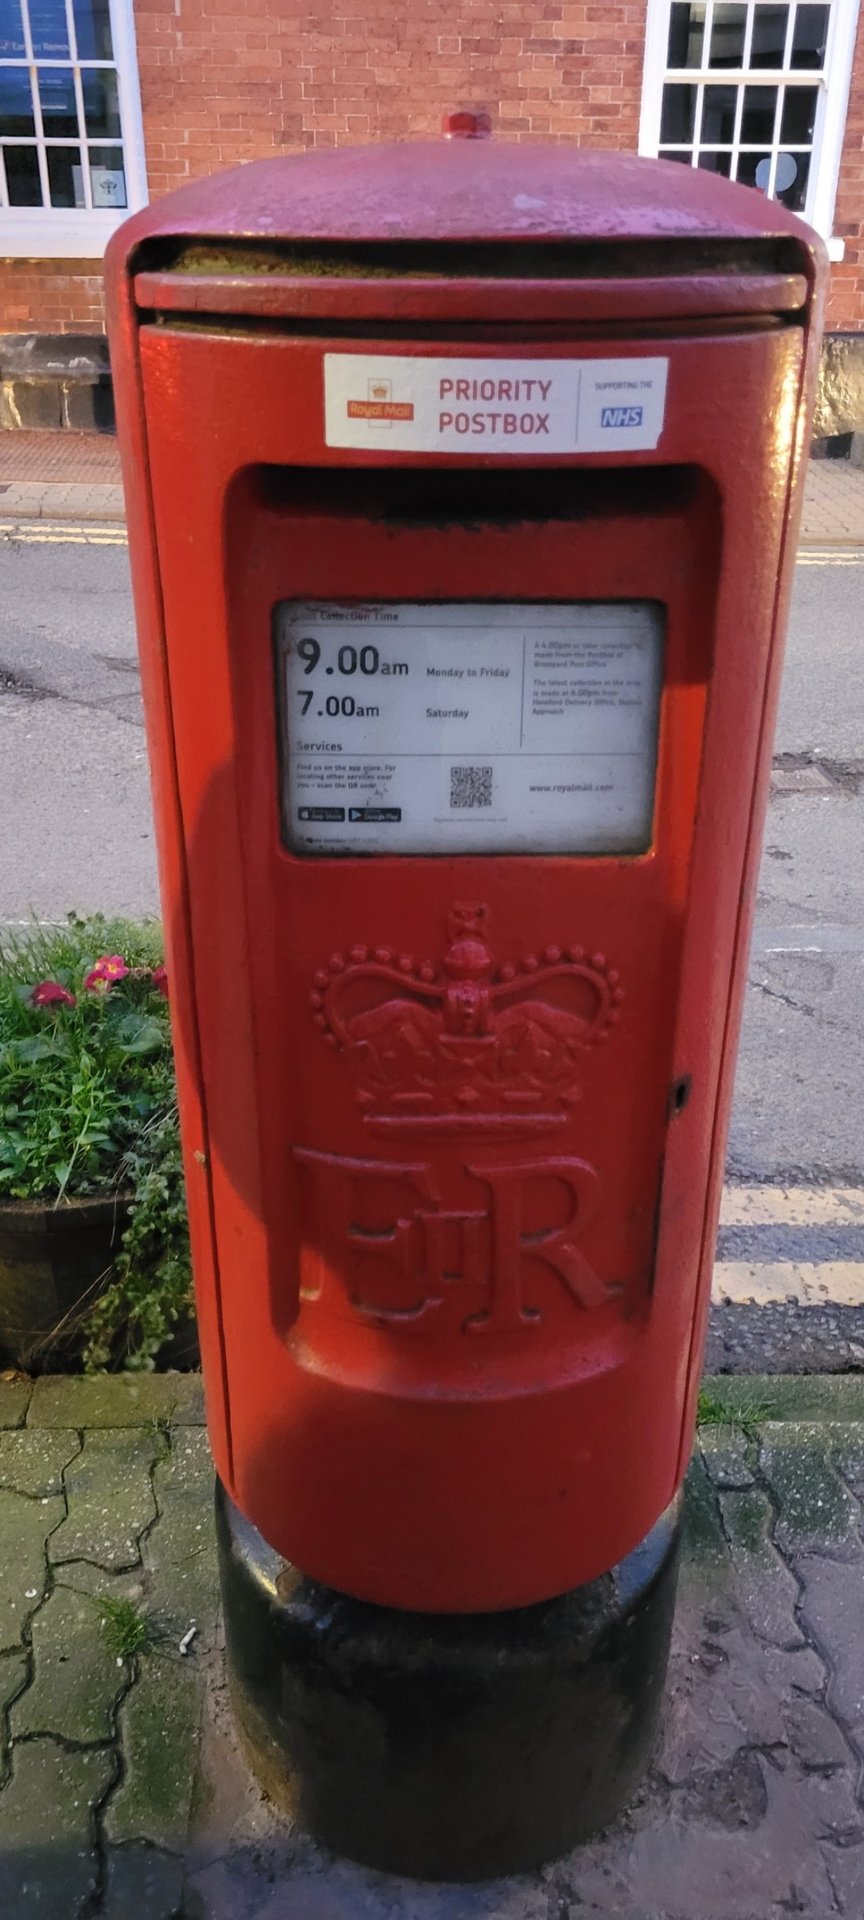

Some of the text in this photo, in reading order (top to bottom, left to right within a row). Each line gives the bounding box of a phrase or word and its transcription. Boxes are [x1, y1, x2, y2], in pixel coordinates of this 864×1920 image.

[439, 378, 552, 401] PRIORITY
[594, 381, 653, 391] SUPPORTING THE
[349, 403, 412, 417] Royal Mail
[602, 409, 642, 427] NHS
[438, 412, 551, 435] POSTBOX
[320, 611, 371, 621] Collection
[374, 611, 399, 621] Time
[296, 637, 409, 676] 9.00am
[586, 660, 607, 668] Office
[426, 667, 511, 679] Monday to Friday
[297, 691, 380, 717] 7.00am
[565, 698, 592, 707] Delivery
[426, 708, 469, 720] Saturday
[296, 741, 343, 752] Services
[296, 763, 311, 771] Find
[335, 763, 346, 771] the
[384, 763, 397, 771] For
[296, 772, 324, 781] locating
[326, 772, 345, 780] other
[347, 772, 375, 780] services
[348, 782, 358, 790] QR
[529, 783, 614, 793] www.royalmail.com
[364, 813, 399, 821] Google Play
